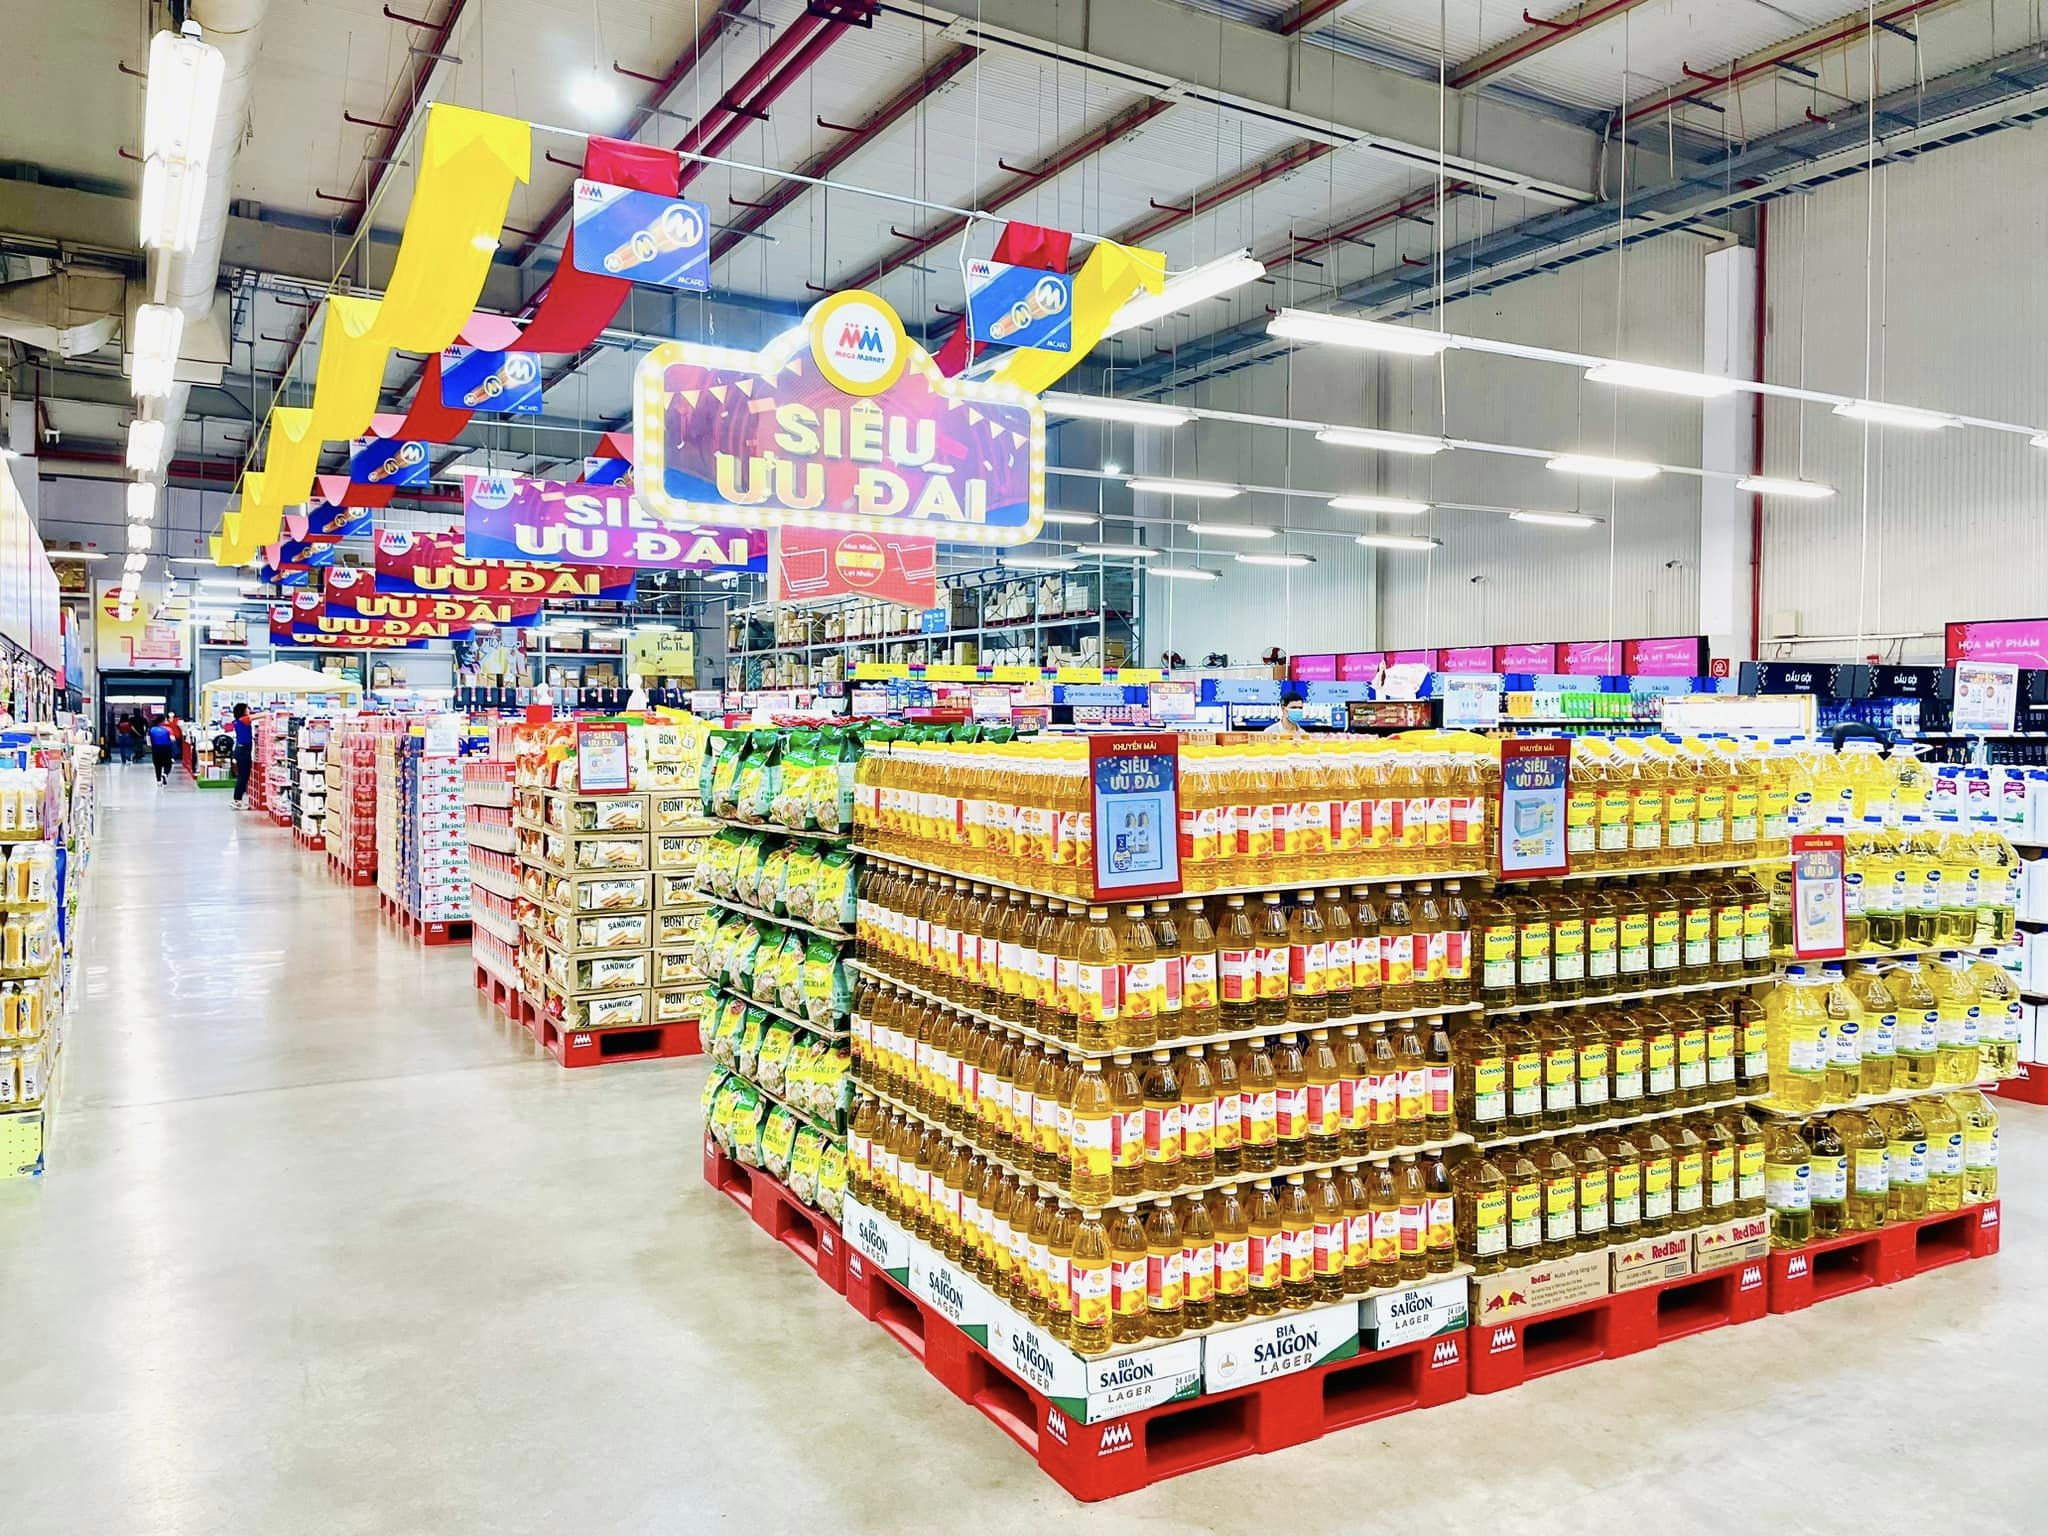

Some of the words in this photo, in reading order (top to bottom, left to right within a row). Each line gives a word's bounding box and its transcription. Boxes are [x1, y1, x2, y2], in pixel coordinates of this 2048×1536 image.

[774, 399, 936, 467] SIÊU
[715, 450, 825, 509] ƯU
[854, 462, 986, 524] ĐÃI
[514, 523, 608, 558] ƯU
[633, 529, 749, 566] ĐÃI
[413, 565, 489, 591] ƯU
[507, 567, 600, 595] ĐÃI
[1112, 740, 1142, 751] KHUYẾN
[1119, 756, 1149, 774] SIÊU
[1524, 757, 1548, 773] SIÊU
[1110, 775, 1130, 790] ƯU
[1134, 772, 1161, 789] ĐÃI
[1516, 774, 1532, 787] ƯU
[1534, 771, 1555, 786] ĐÃI
[608, 921, 642, 930] SANDWICH
[869, 1219, 878, 1231] BIA
[1732, 1226, 1750, 1241] Red
[1750, 1220, 1766, 1237] Bull
[858, 1223, 888, 1255] SAIGON
[1651, 1244, 1669, 1259] Red
[1669, 1238, 1686, 1257] Bull
[861, 1244, 886, 1265] LAGER
[941, 1268, 951, 1283] BIA
[929, 1271, 963, 1311] SAIGON
[1405, 1291, 1418, 1301] BIA
[932, 1293, 960, 1321] LAGER
[1391, 1296, 1433, 1318] SAIGON
[1276, 1324, 1296, 1339] BIA
[1395, 1314, 1430, 1330] LAGER
[1026, 1331, 1039, 1347] BIA
[1254, 1331, 1319, 1363] SAIGON
[1012, 1334, 1054, 1380] SAIGON
[1118, 1358, 1135, 1369] BIA
[1260, 1352, 1313, 1376] LAGER
[1016, 1357, 1050, 1391] LAGER
[1100, 1363, 1154, 1388] SAIGON
[1107, 1385, 1152, 1403] LAGER
